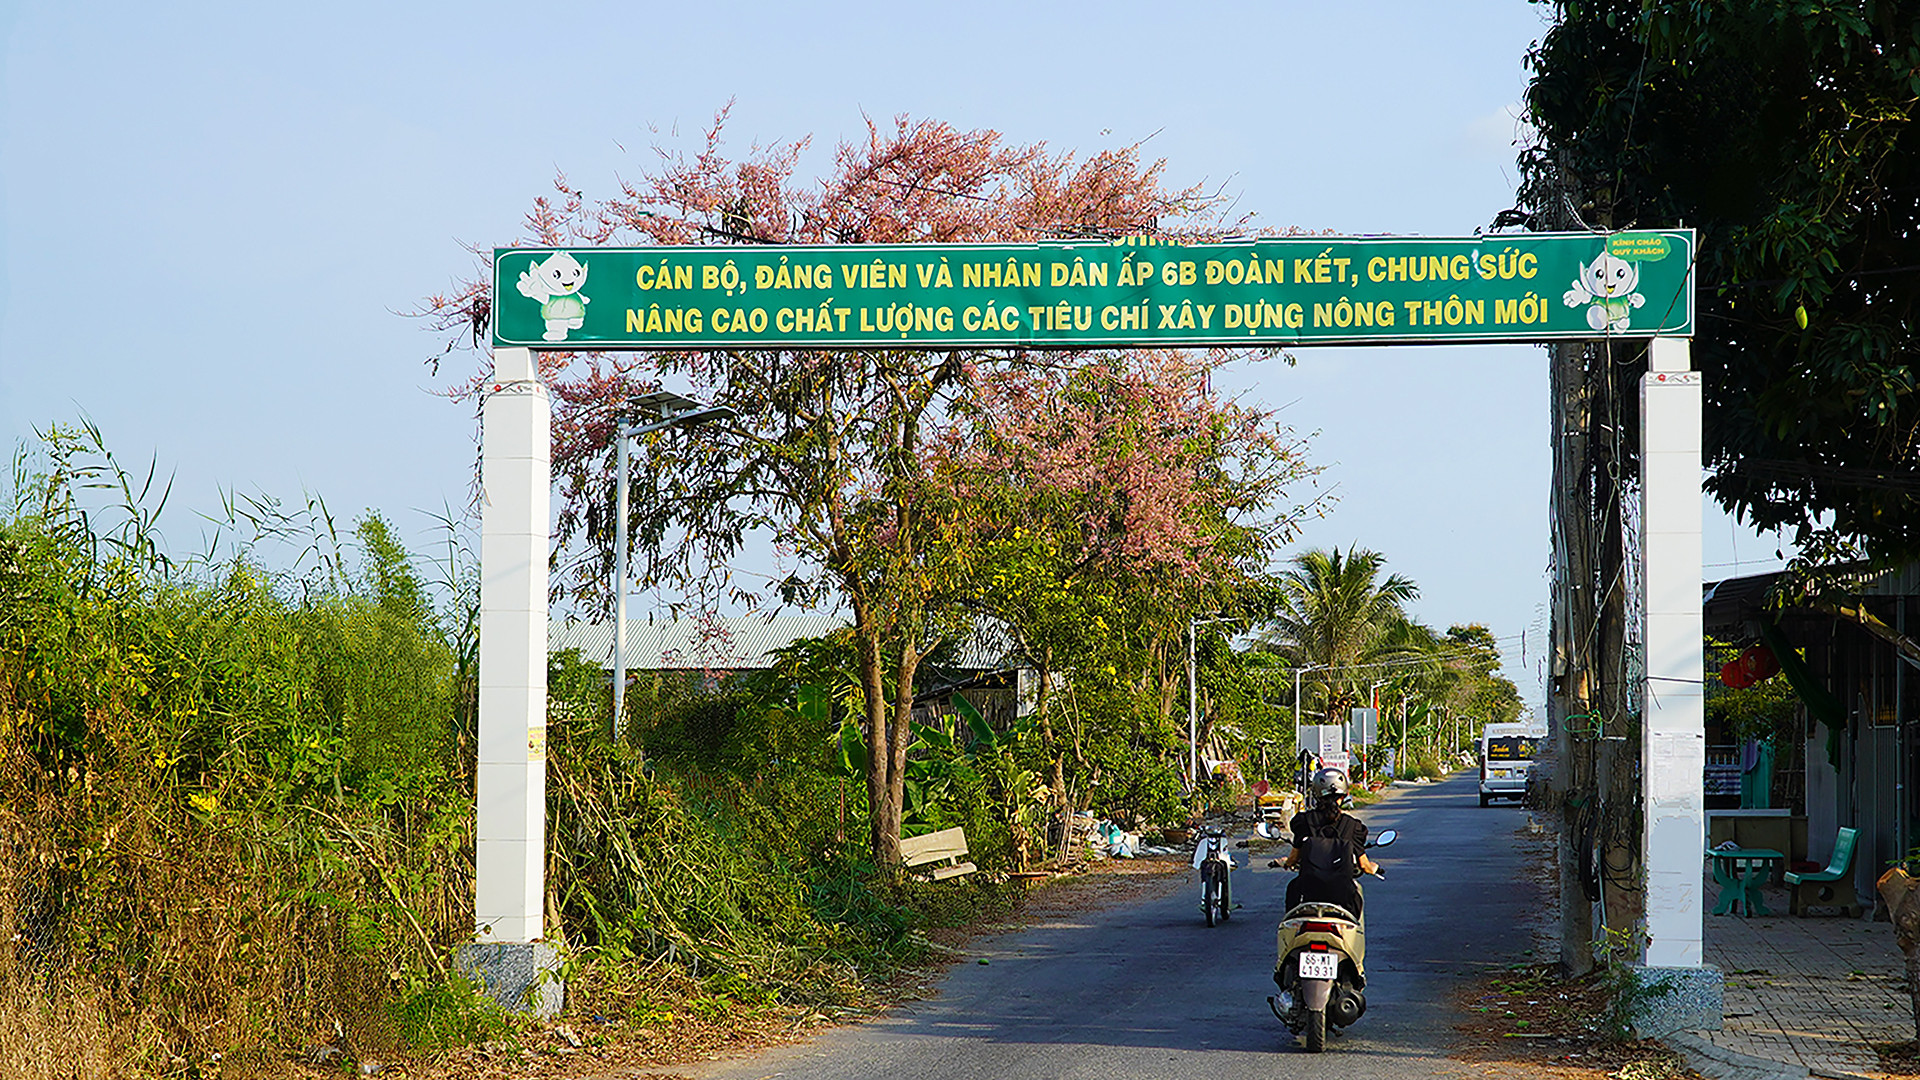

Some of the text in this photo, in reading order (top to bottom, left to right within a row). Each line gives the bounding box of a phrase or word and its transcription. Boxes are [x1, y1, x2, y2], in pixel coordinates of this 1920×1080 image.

[636, 247, 1538, 297] CÁN BỘ, ĐẢNG VIÊN VÀ NHÂN DÂN ẤP 6B ĐOÀN KẾT, CHUNG SỨC
[626, 291, 1548, 339] NÂNG CAO CHẤT LƯỢNG CÁC TIÊU CHÍ XÂY DỰNG NÔNG THÔN MỚI
